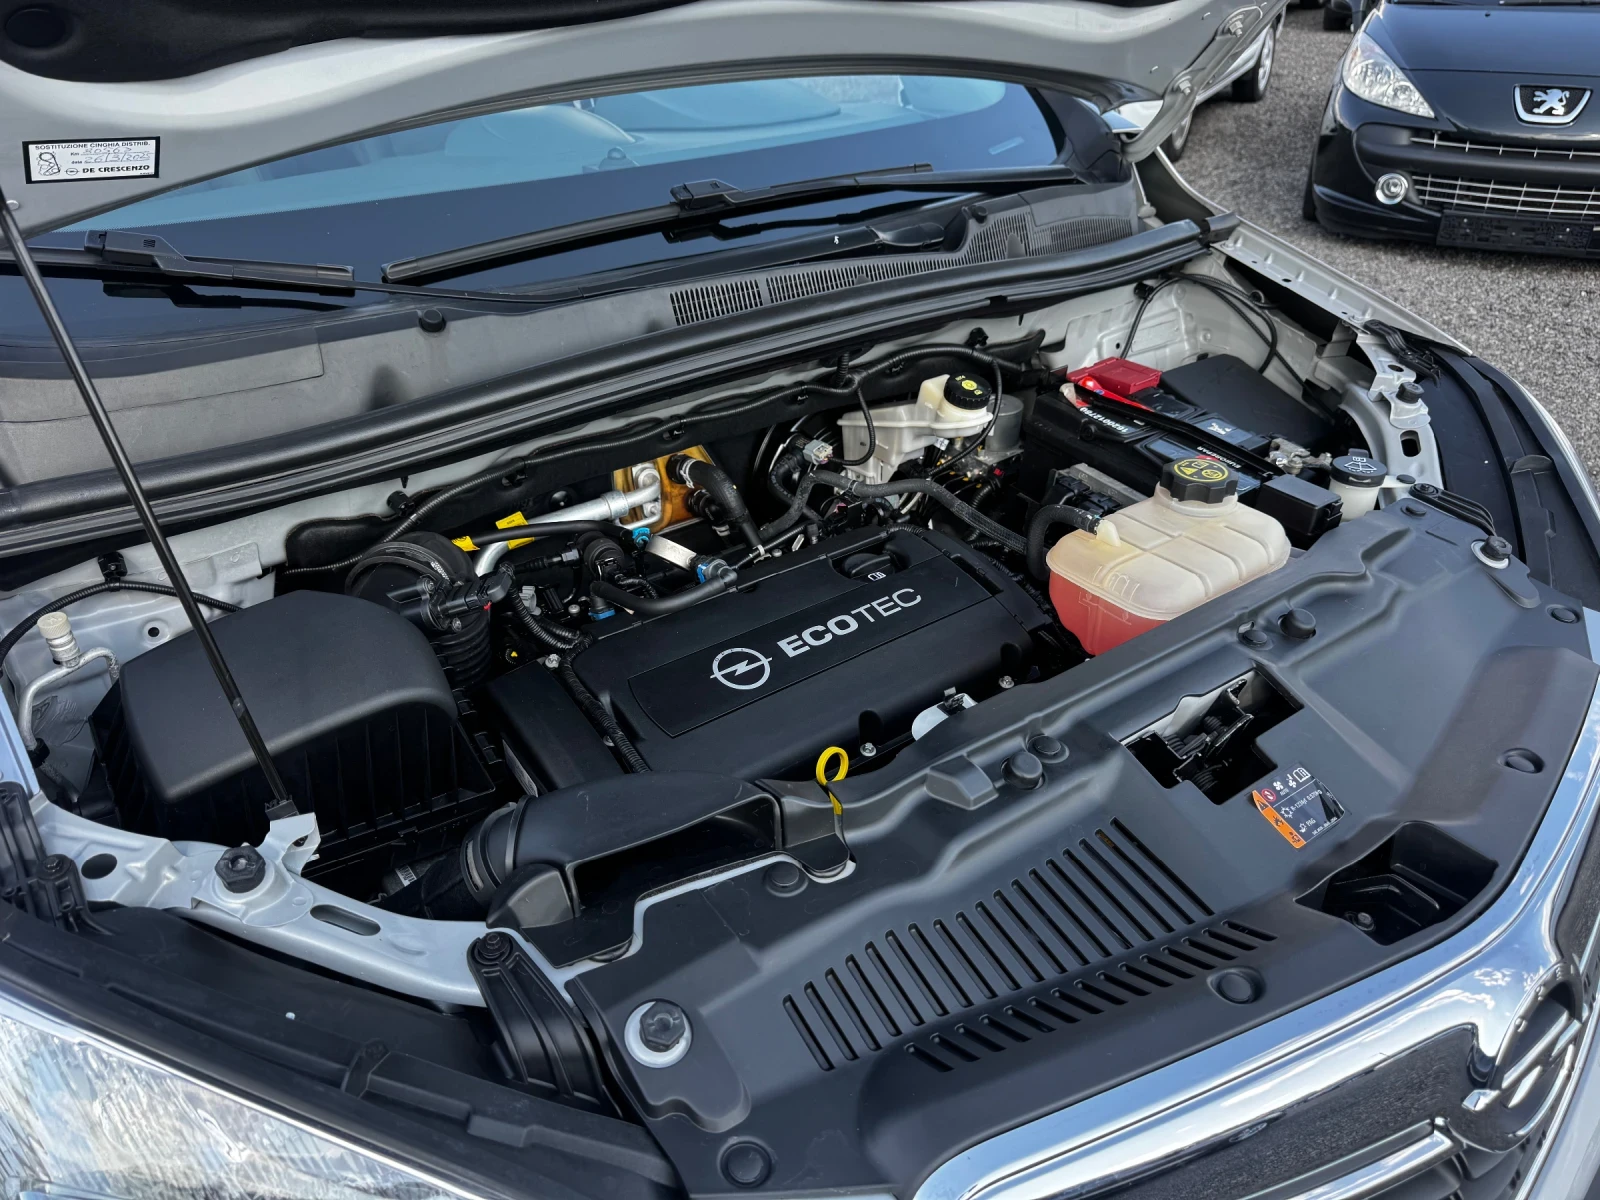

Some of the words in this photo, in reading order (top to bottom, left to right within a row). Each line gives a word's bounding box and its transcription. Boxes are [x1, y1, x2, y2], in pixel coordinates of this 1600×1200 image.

[98, 165, 150, 173] CRESCENZO
[1196, 445, 1242, 469] EUROREPAR
[776, 588, 922, 658] ECOTEC
[1306, 818, 1316, 826] PAG
